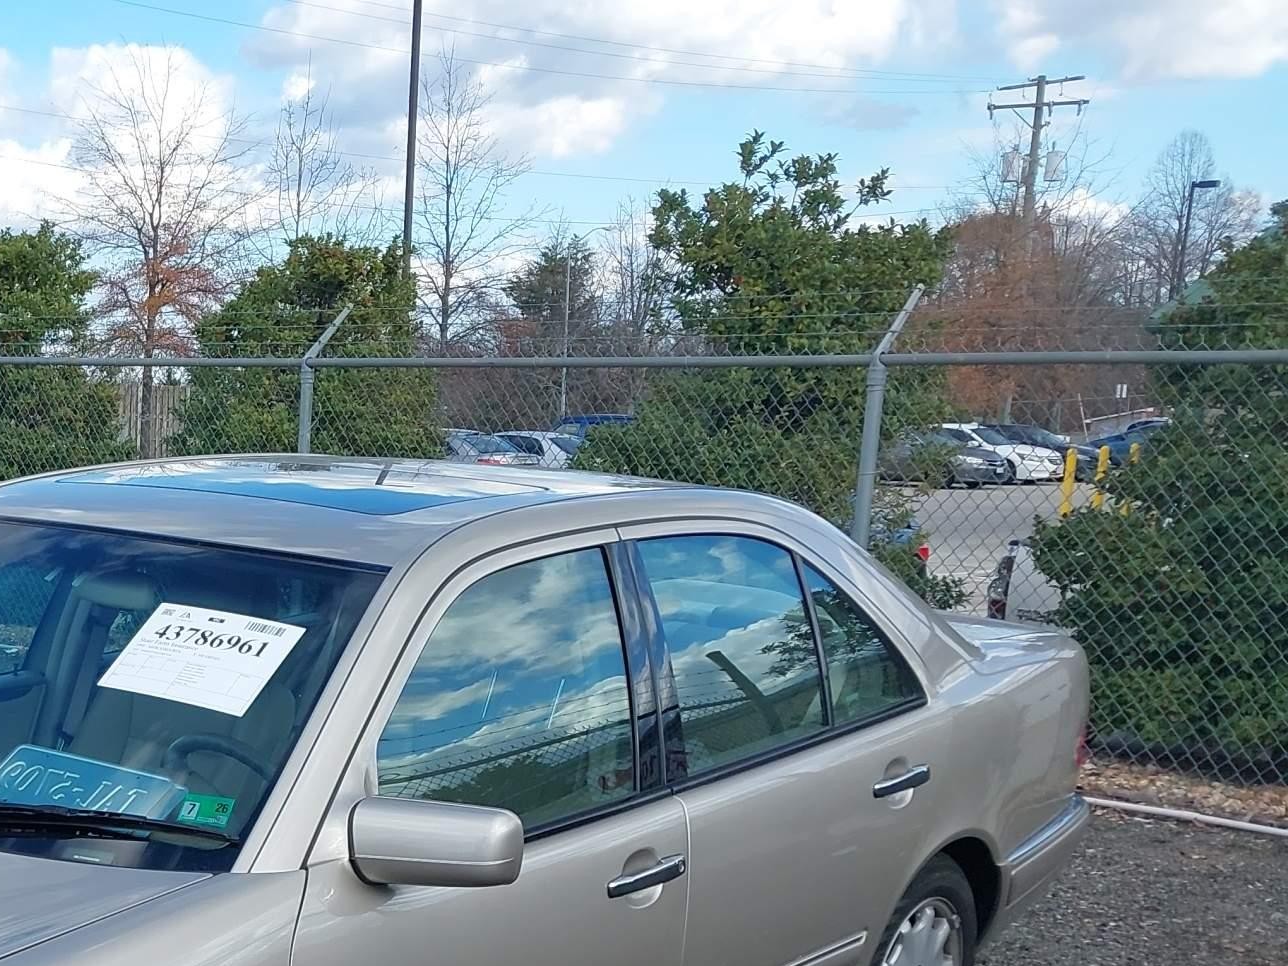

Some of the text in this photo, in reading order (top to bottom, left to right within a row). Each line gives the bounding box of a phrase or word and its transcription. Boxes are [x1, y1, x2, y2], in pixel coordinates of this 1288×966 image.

[154, 623, 270, 658] 43786961
[187, 803, 197, 815] 7
[215, 802, 229, 814] 26
